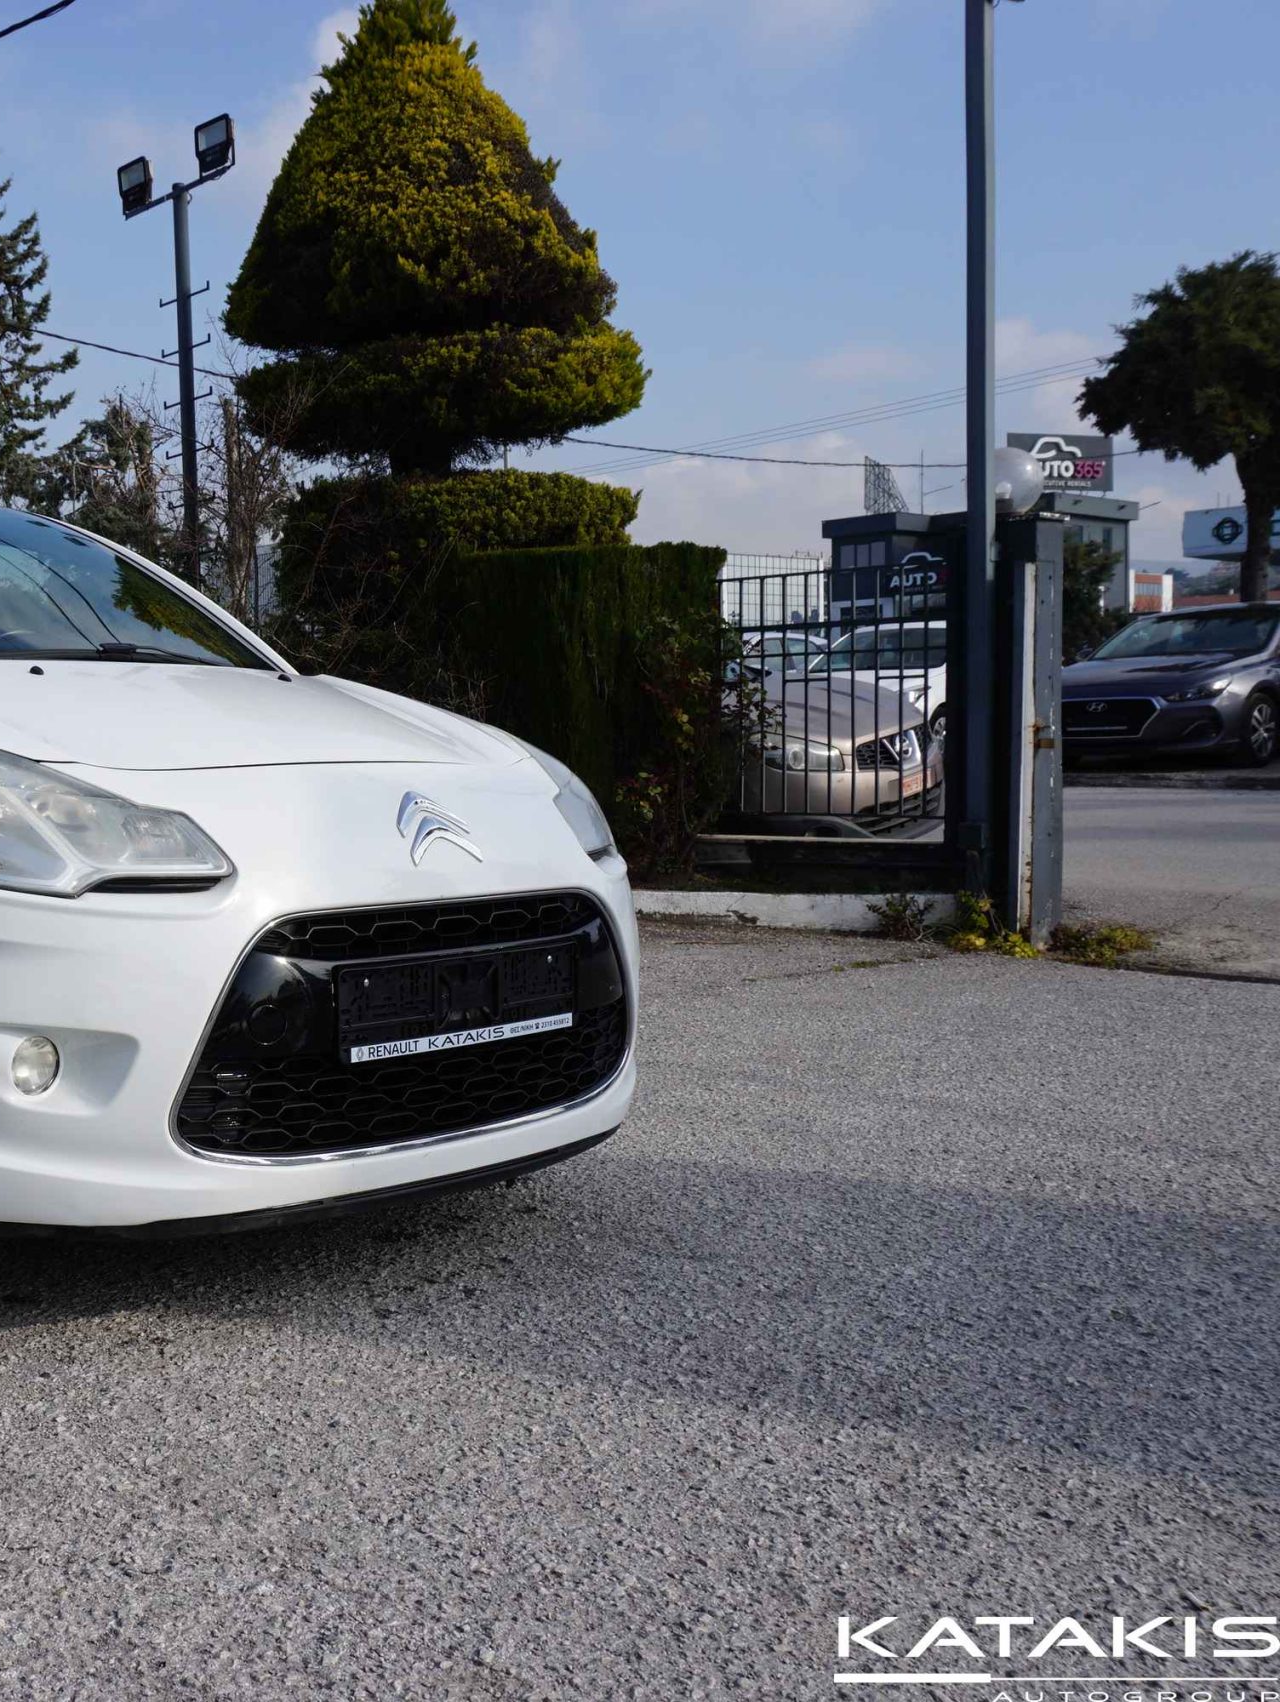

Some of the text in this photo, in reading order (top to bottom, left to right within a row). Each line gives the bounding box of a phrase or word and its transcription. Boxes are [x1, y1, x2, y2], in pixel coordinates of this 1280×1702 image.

[1038, 460, 1105, 478] UTO365
[889, 570, 946, 588] AUTO
[368, 1040, 419, 1059] RENAULT
[428, 1026, 505, 1049] KATAKIS
